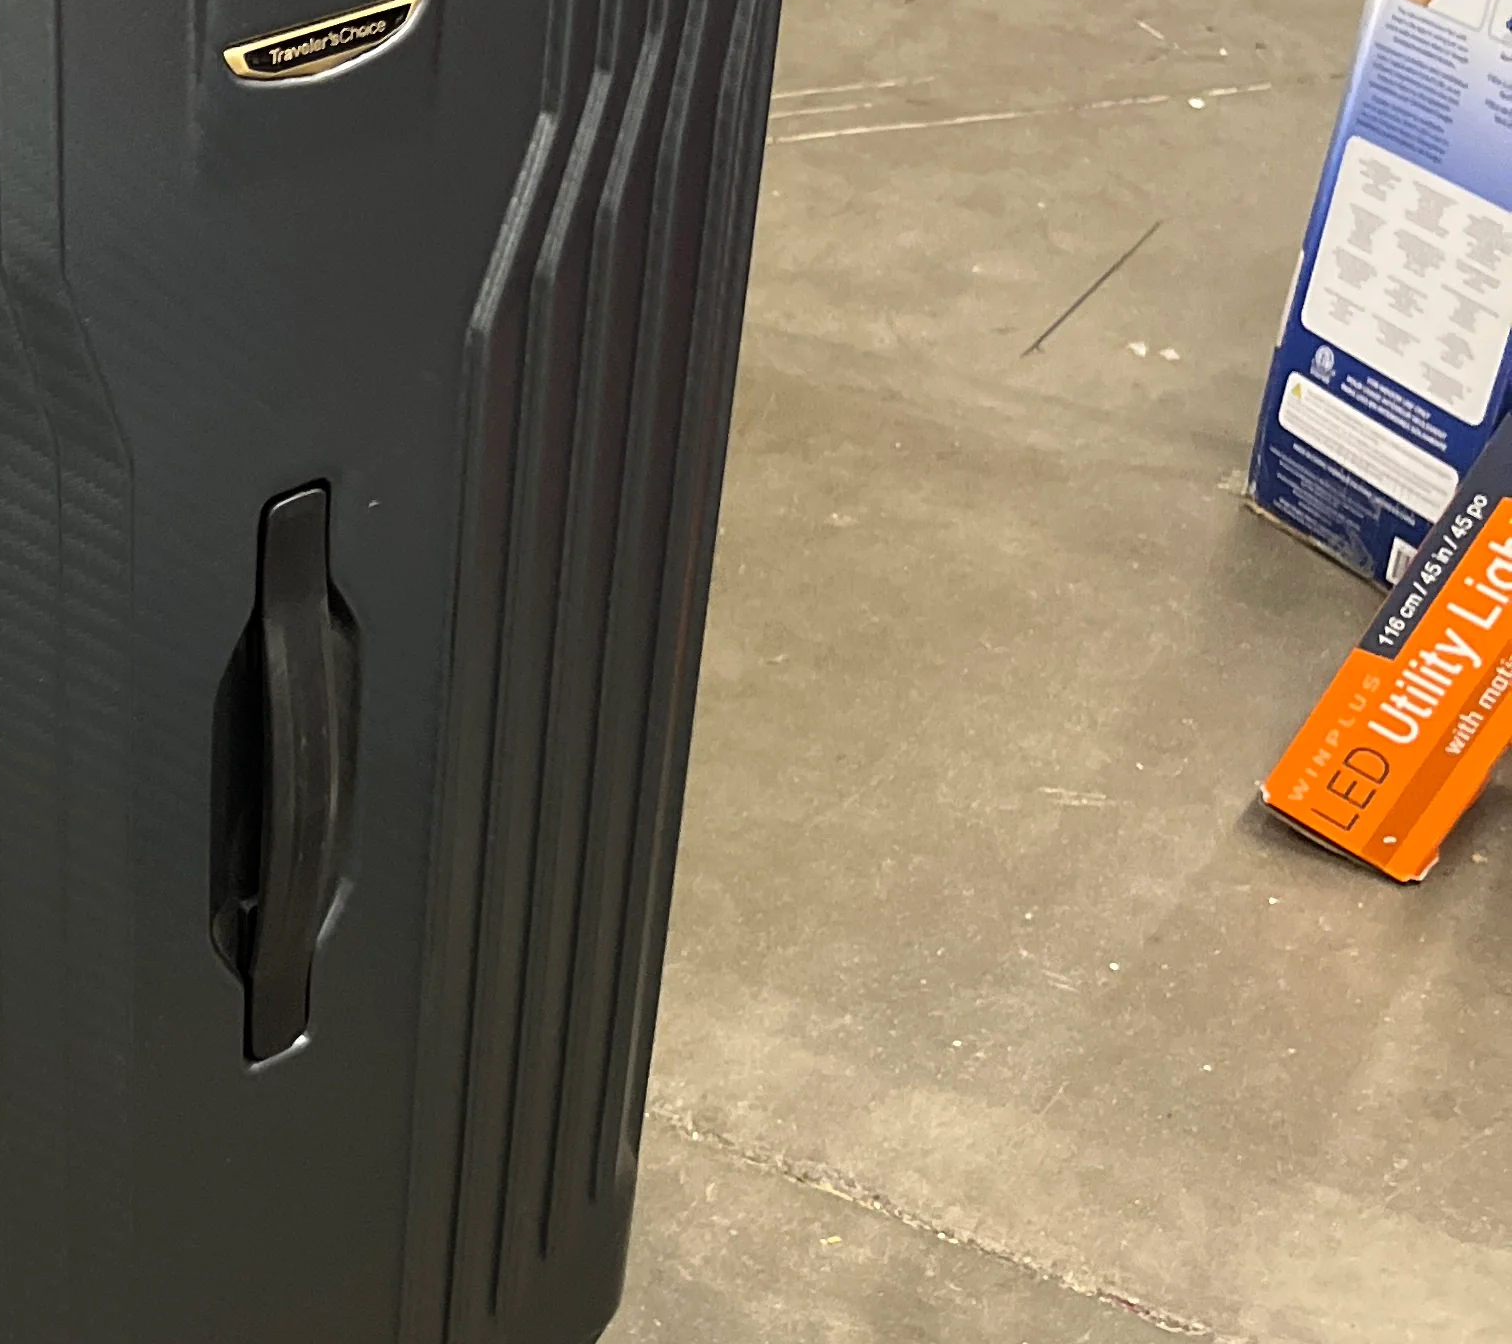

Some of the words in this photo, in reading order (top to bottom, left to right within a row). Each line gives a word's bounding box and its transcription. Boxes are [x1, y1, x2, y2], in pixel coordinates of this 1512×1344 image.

[1466, 494, 1488, 521] po
[1450, 514, 1473, 540] 45
[1431, 546, 1455, 565] in
[1443, 534, 1458, 550] /
[1420, 560, 1443, 585] 45
[1413, 580, 1428, 596] /
[1400, 592, 1424, 619] cm
[1378, 616, 1406, 646] 116
[1288, 673, 1381, 802] WINPLUS
[1310, 746, 1390, 833] LED
[1367, 627, 1483, 745] Utility
[1444, 710, 1485, 755] with
